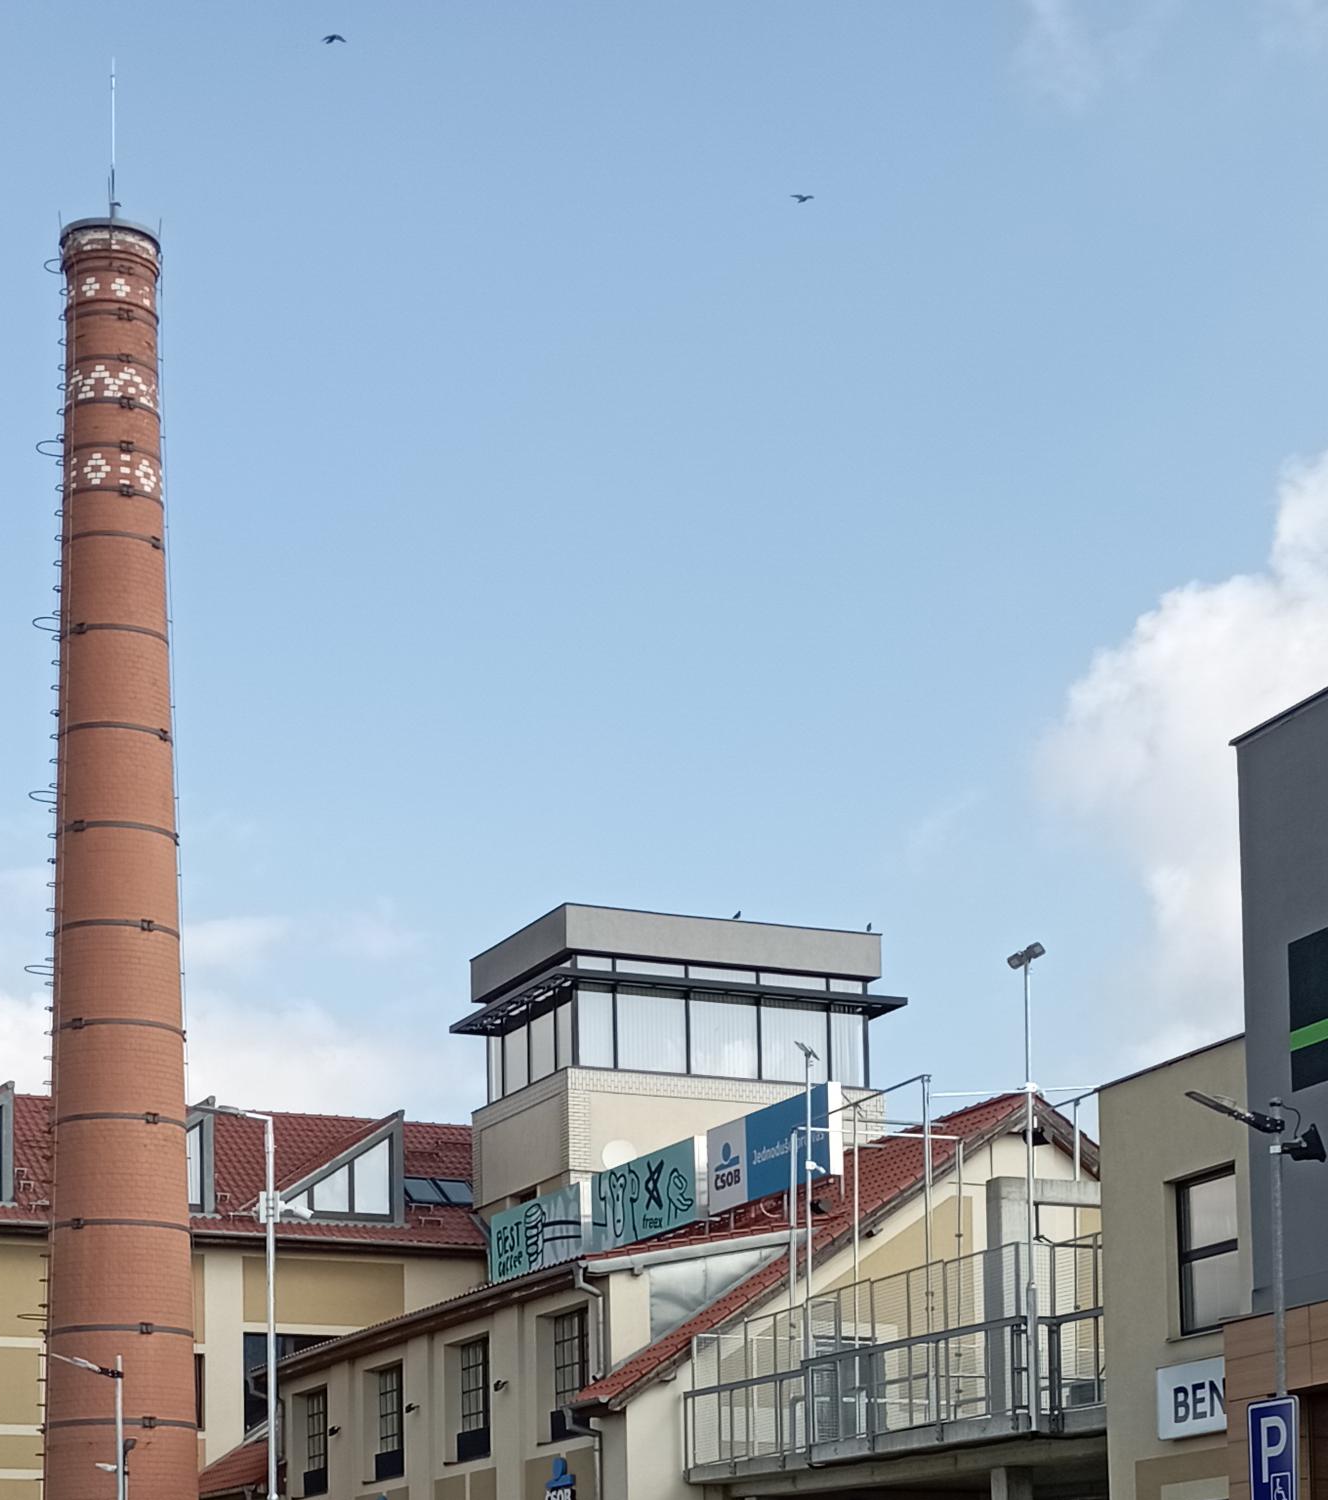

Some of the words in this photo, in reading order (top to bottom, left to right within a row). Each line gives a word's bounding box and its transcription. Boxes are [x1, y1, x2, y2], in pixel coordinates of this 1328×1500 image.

[714, 1168, 741, 1191] ČSOB
[642, 1213, 663, 1230] freex
[497, 1221, 521, 1256] BEST
